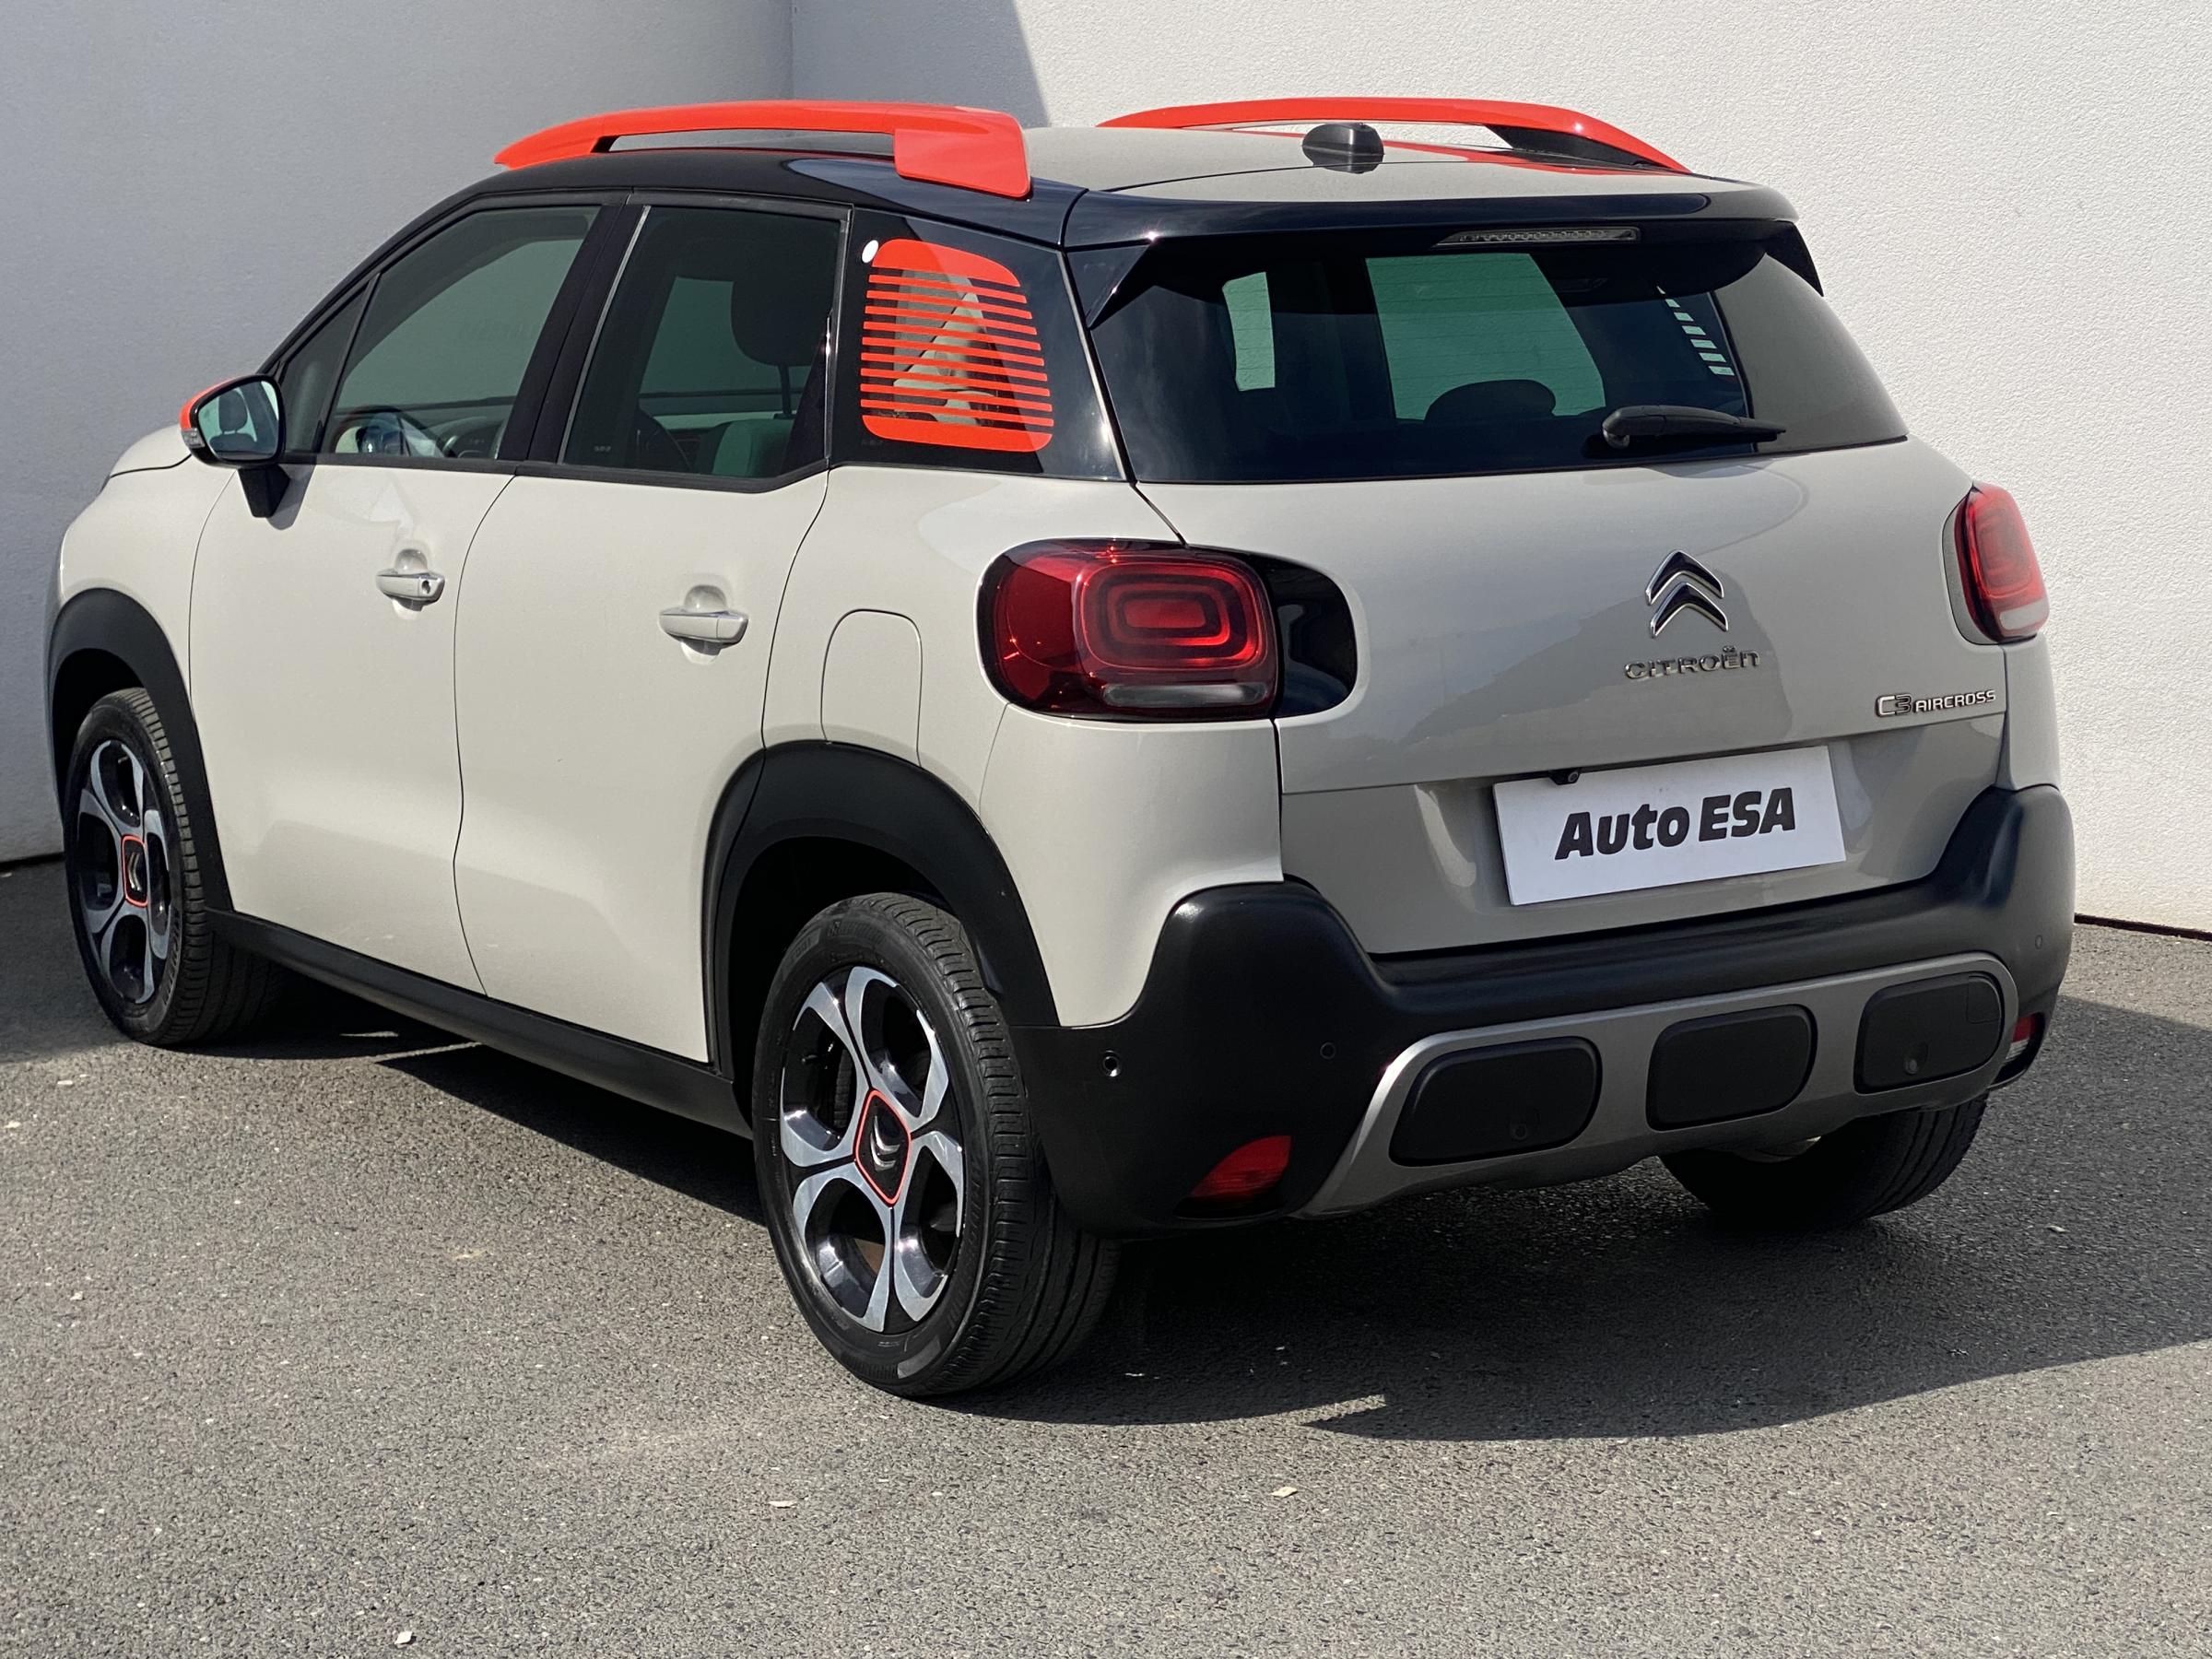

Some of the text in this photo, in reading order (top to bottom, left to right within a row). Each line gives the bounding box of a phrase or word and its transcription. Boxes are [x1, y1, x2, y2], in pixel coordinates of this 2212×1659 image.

[1625, 645, 1759, 679] CITROËN
[1876, 689, 1996, 717] C3 AIRCROSS
[1555, 787, 1796, 860] Auto ESA
